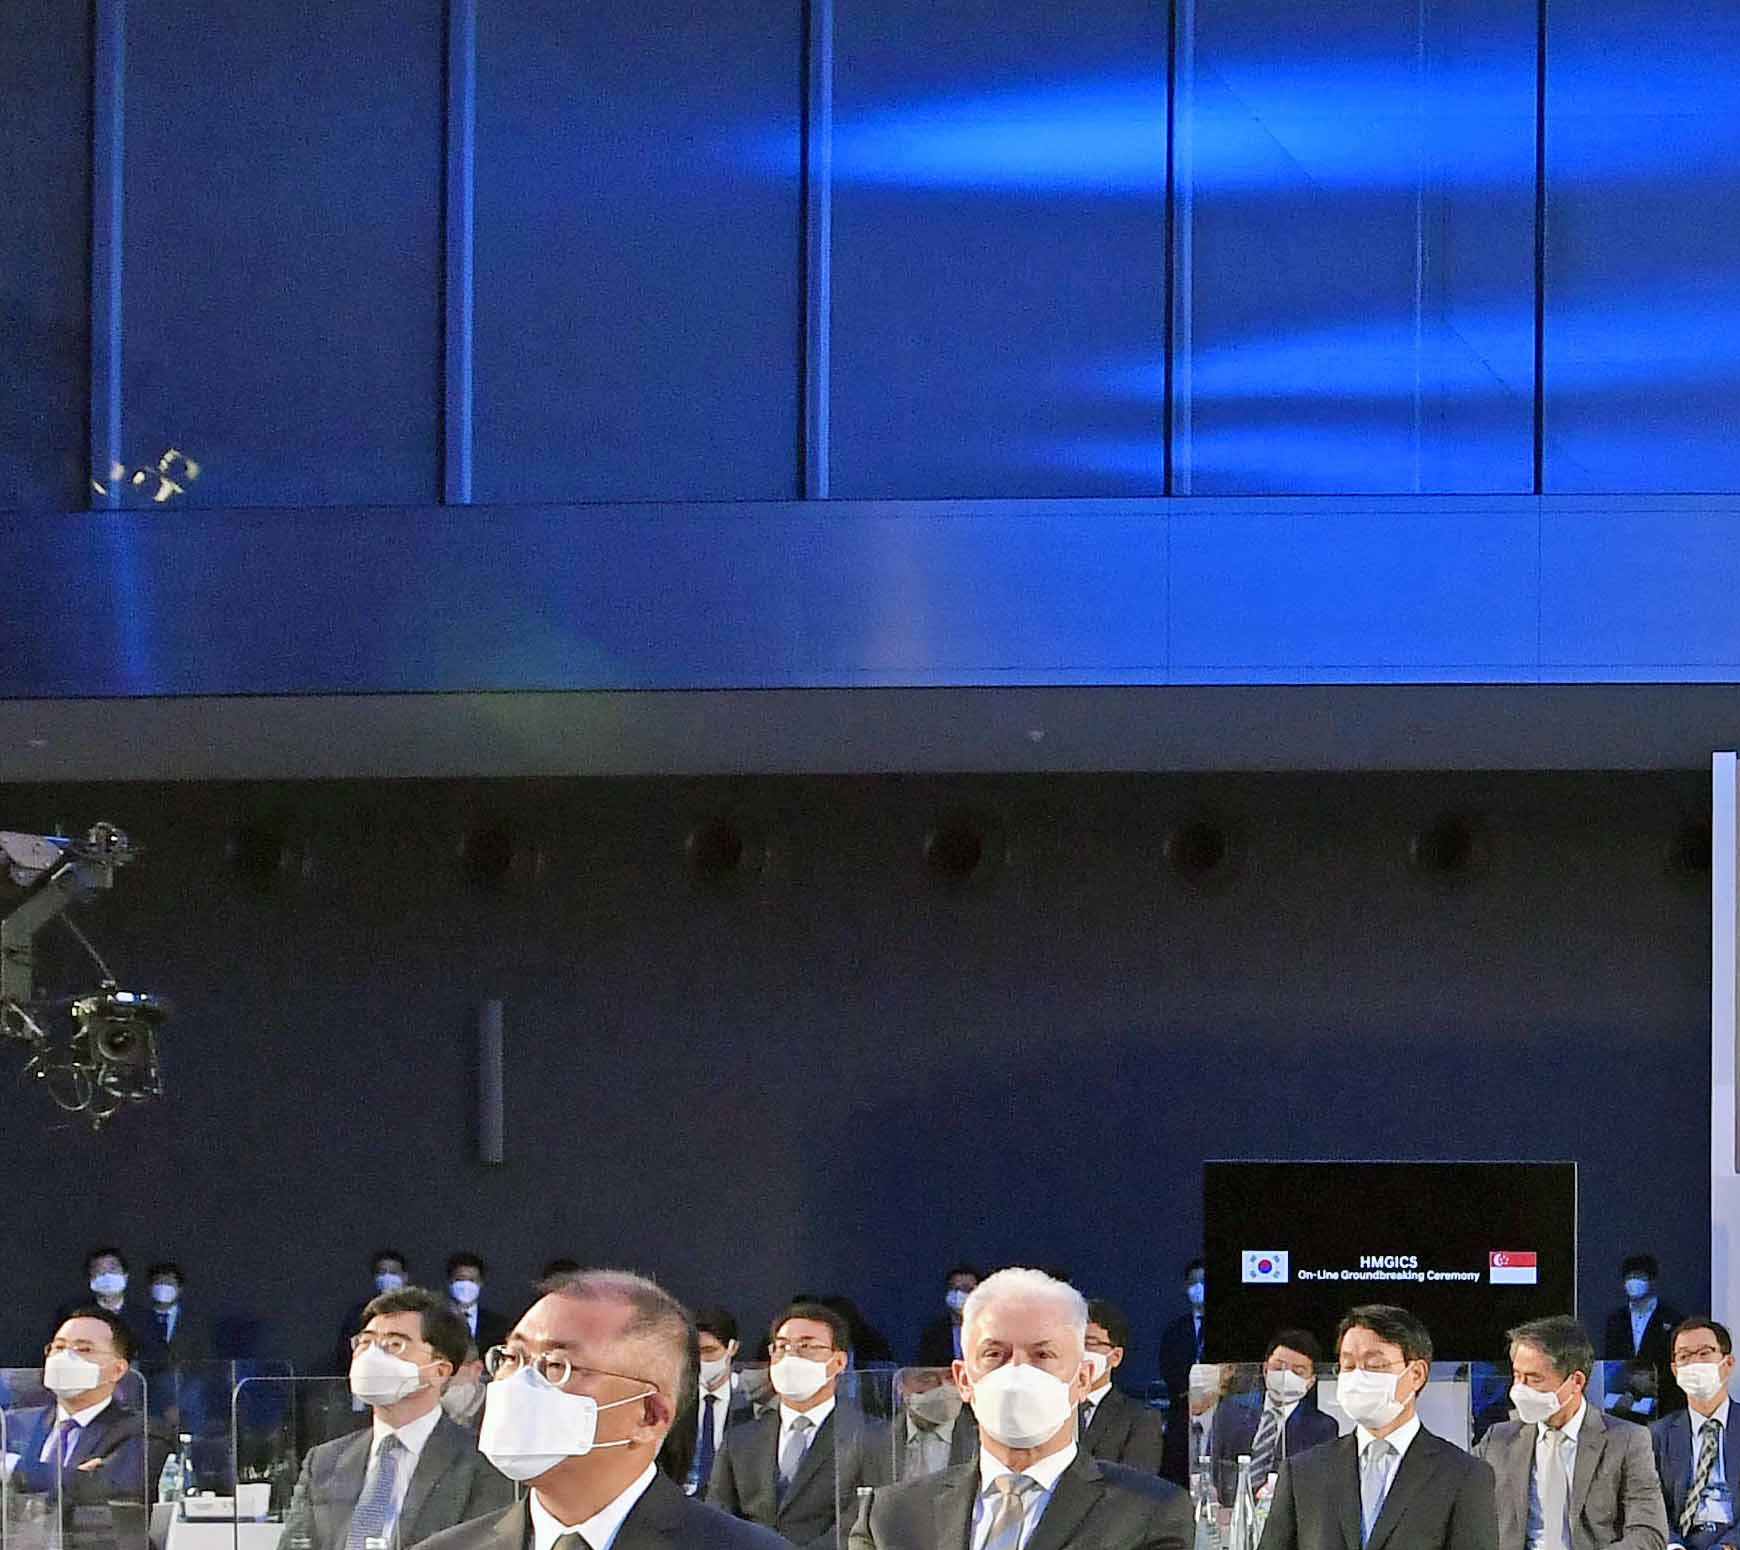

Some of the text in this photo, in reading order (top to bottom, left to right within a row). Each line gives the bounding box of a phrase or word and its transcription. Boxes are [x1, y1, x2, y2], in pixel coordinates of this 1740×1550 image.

[1359, 1256, 1418, 1268] HMGICS
[1298, 1270, 1480, 1282] On-Line Groundbreaking Ceremony
